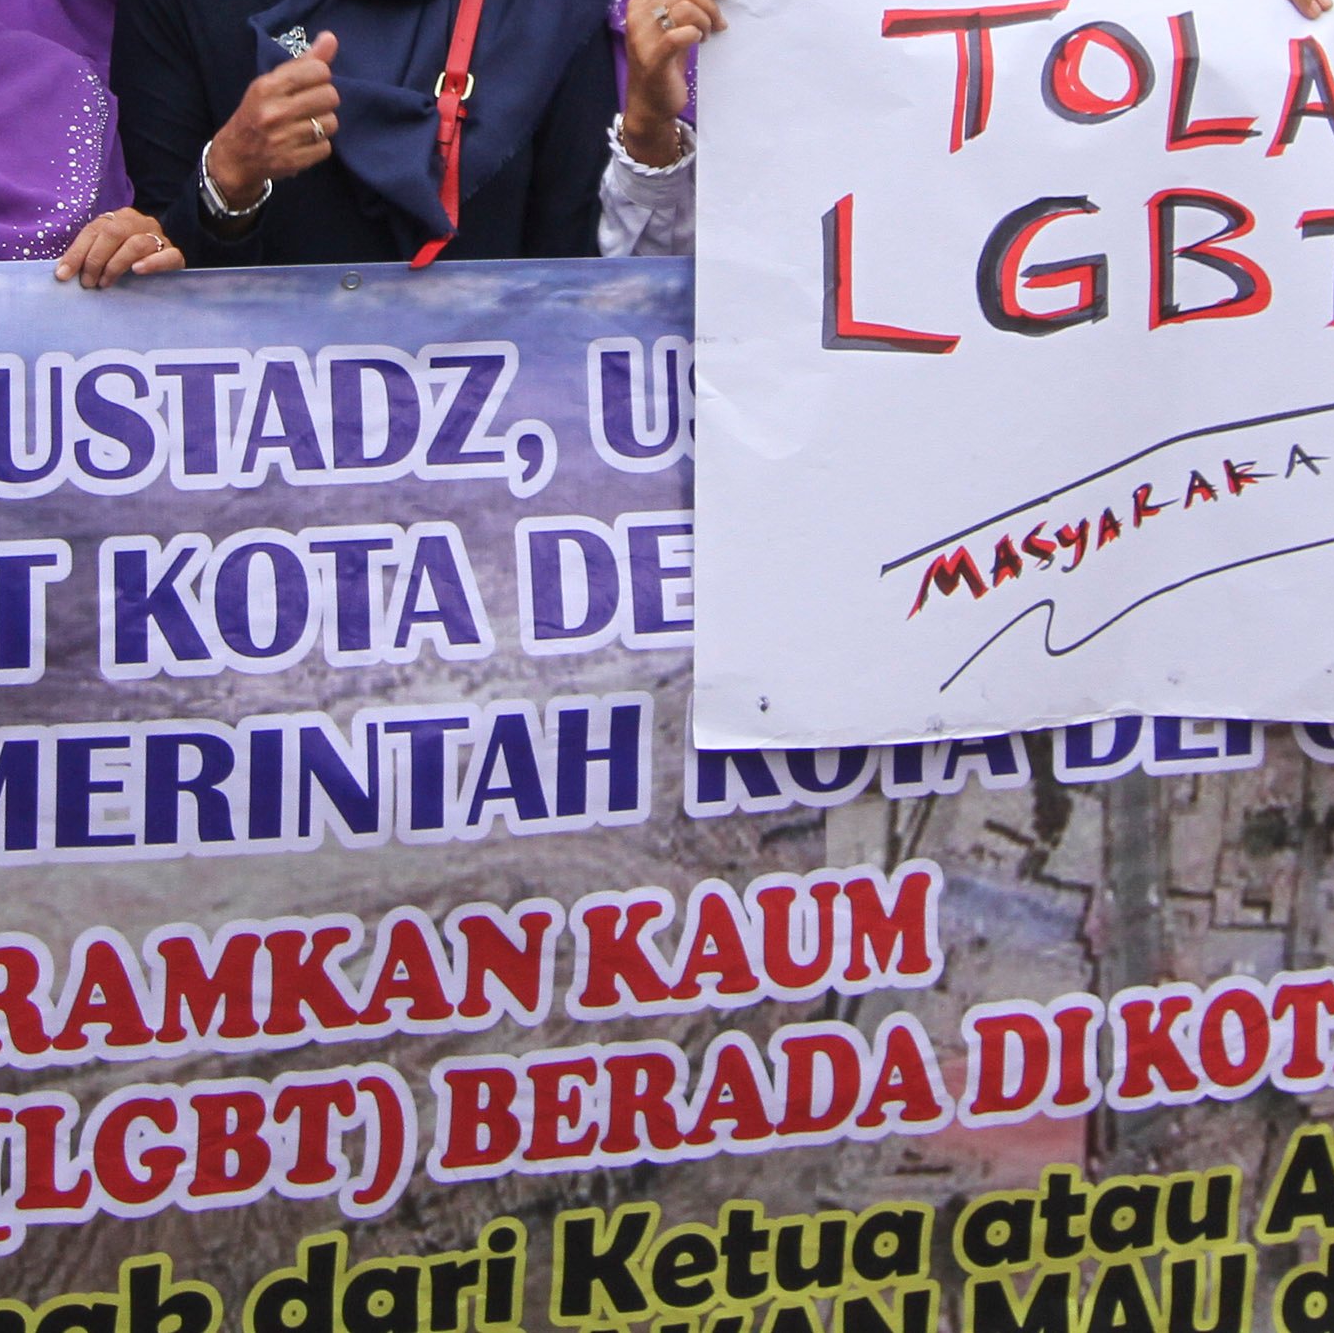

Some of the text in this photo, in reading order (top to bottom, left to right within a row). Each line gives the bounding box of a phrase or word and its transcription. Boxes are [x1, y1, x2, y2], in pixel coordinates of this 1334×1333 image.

[112, 533, 479, 665] KOTA
[578, 871, 933, 1009] KAUM
[440, 1023, 943, 1173] BERADA
[970, 1005, 1094, 1117] DI
[259, 1228, 522, 1333] dari
[559, 1210, 925, 1317] Ketua
[961, 1170, 1233, 1266] atau
